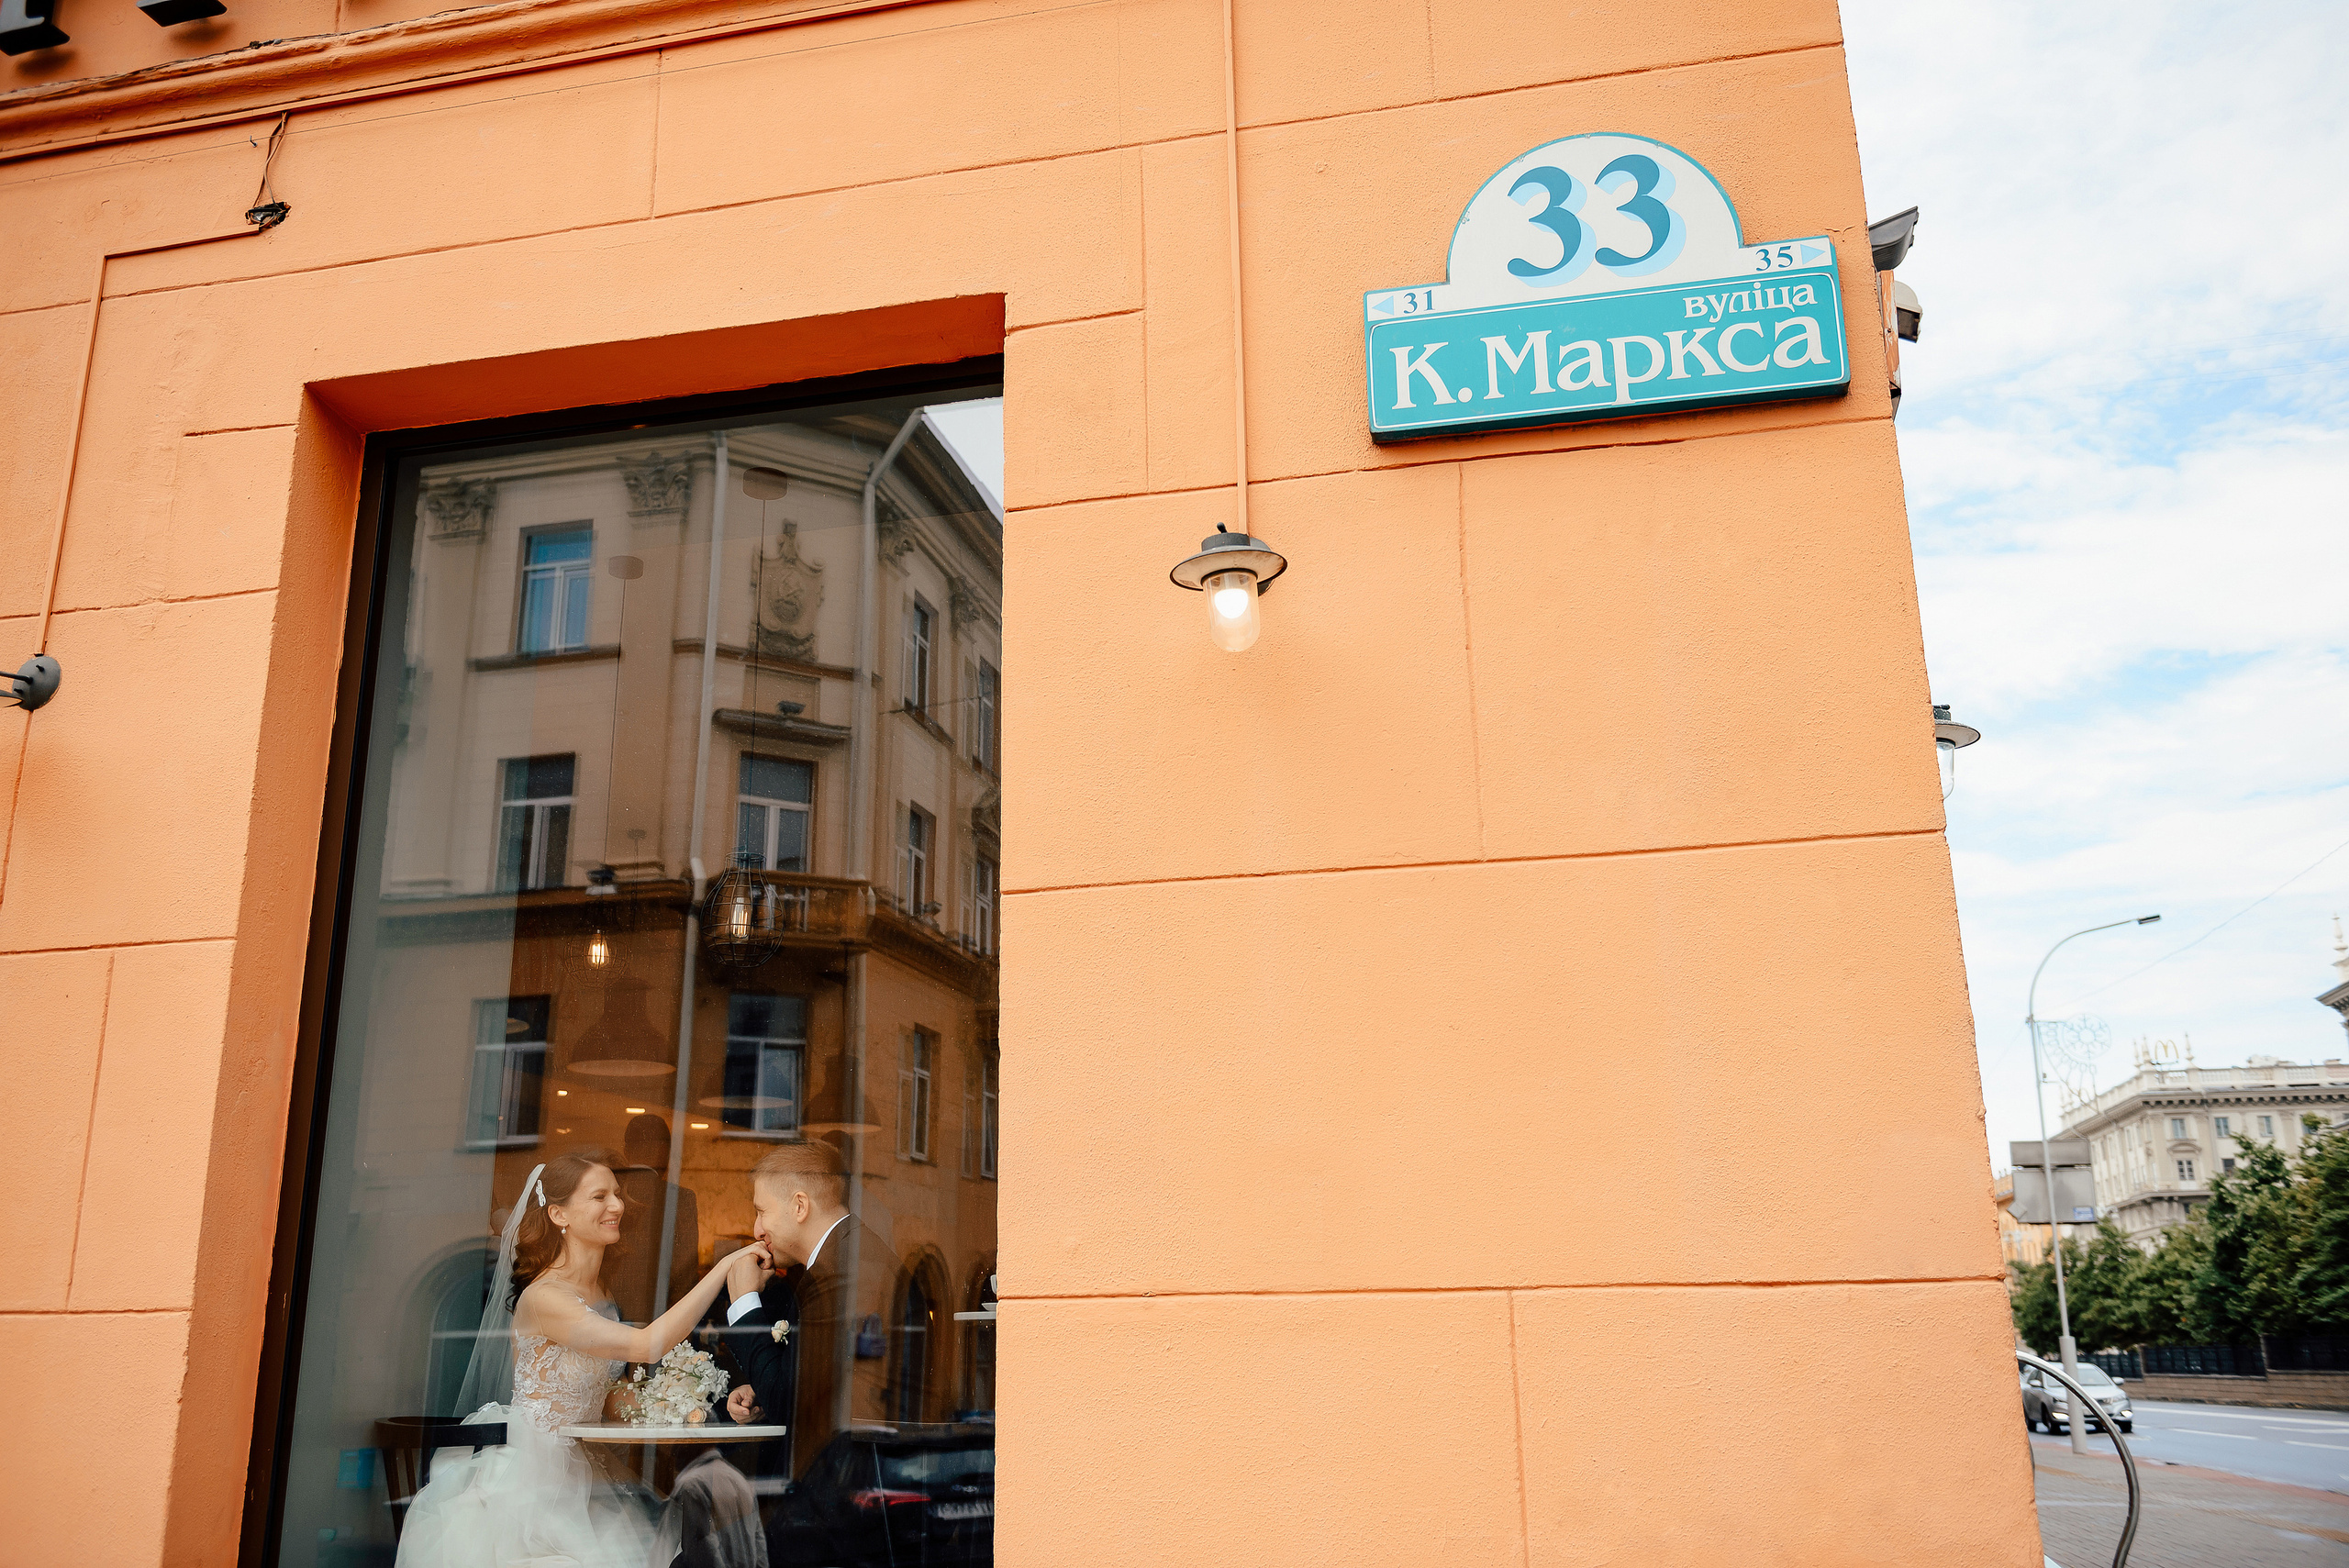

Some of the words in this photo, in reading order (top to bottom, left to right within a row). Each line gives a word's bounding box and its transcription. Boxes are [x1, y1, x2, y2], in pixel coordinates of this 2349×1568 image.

[1507, 154, 1685, 285] 33
[1755, 245, 1794, 272] 35
[1403, 291, 1434, 315] 31
[1684, 281, 1818, 322] вуліца
